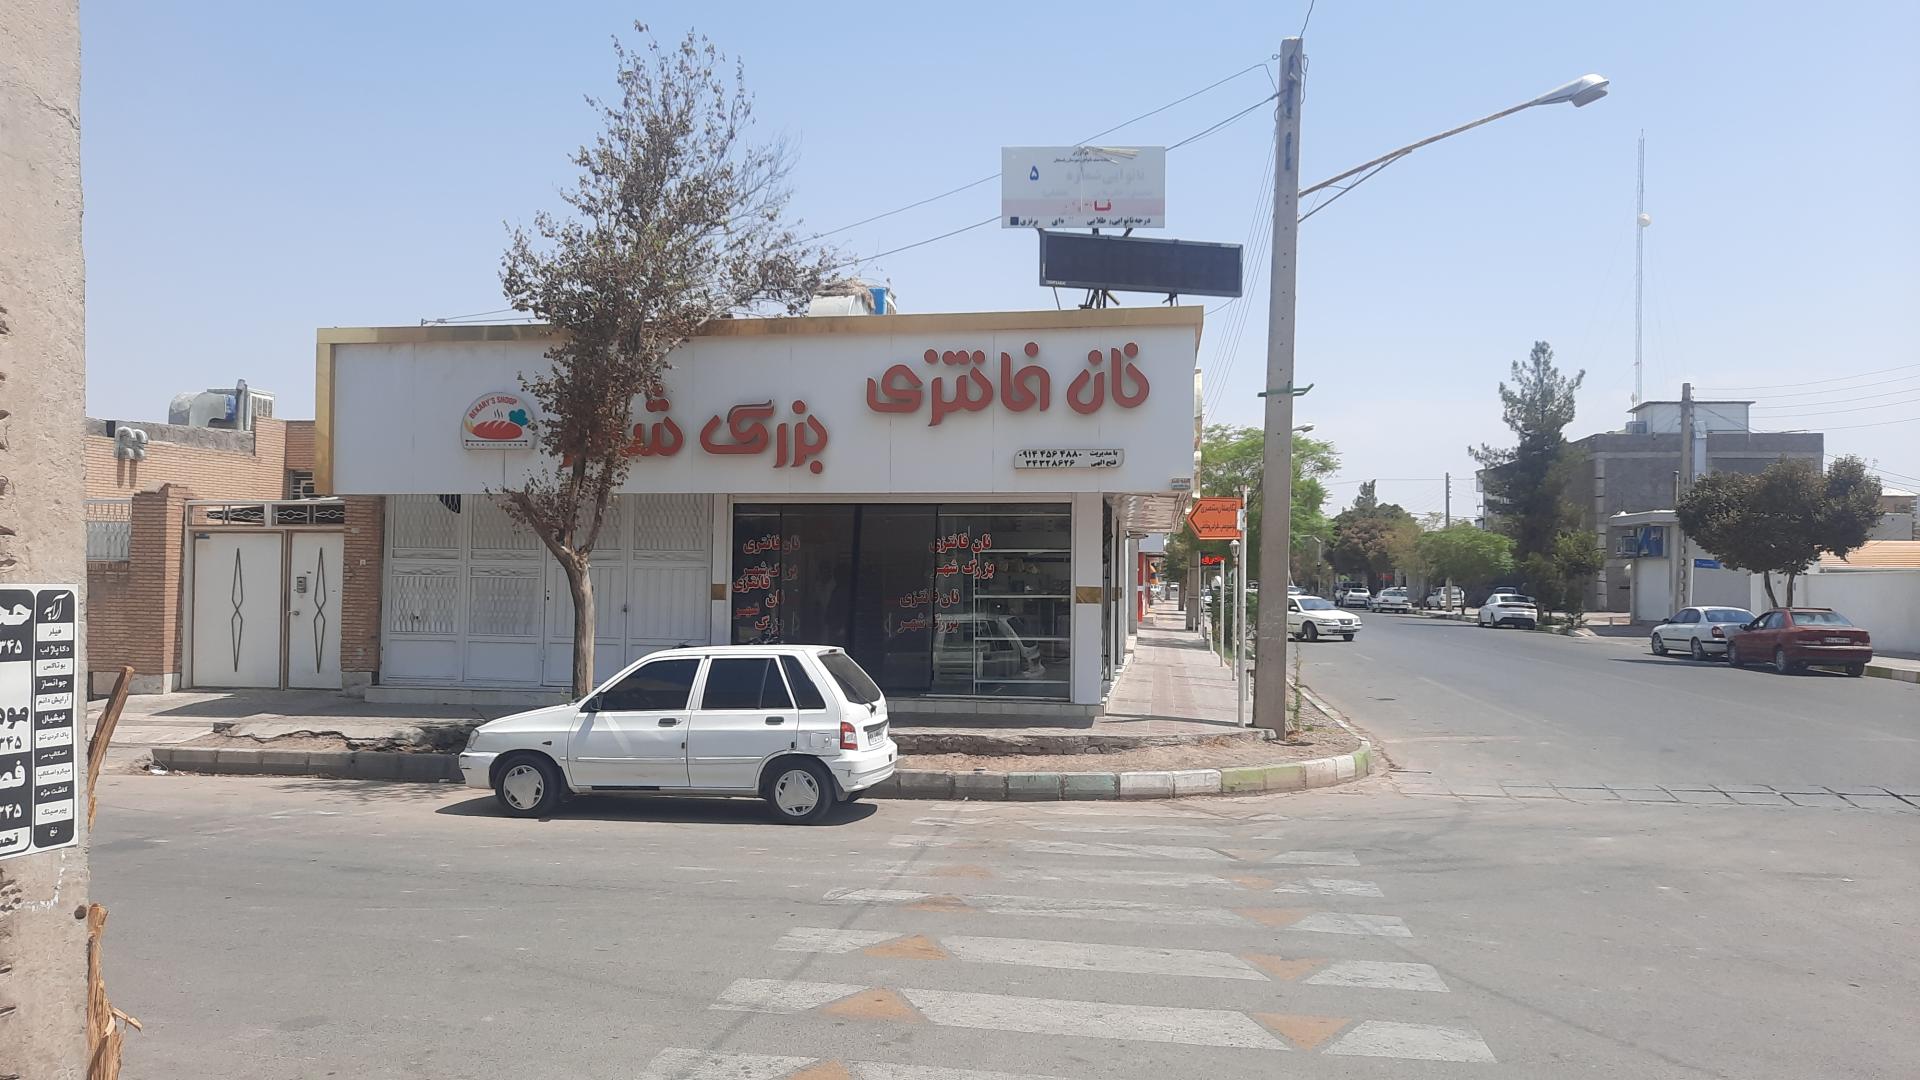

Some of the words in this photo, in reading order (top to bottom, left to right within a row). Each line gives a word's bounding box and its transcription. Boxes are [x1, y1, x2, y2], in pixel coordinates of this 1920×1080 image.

[1029, 165, 1039, 181] ۵
[866, 342, 1051, 427] فانتزی
[1067, 342, 1150, 415] نان
[700, 399, 829, 475] بزرگ
[1089, 450, 1112, 458] مدیریت
[743, 534, 780, 554] فانتزی
[929, 532, 970, 553] فانتزی
[971, 533, 992, 553] نان
[930, 559, 959, 579] شهر
[962, 558, 995, 579] بزرگ
[732, 573, 771, 593] فانتزی
[940, 588, 960, 608] نان
[49, 627, 62, 637] فیلر
[898, 612, 926, 633] شهر
[43, 662, 66, 671] بوتاکس
[41, 679, 68, 690] جوانساز
[41, 711, 66, 725] فیشیال
[40, 788, 51, 799] مژه
[51, 785, 68, 795] کاشت
